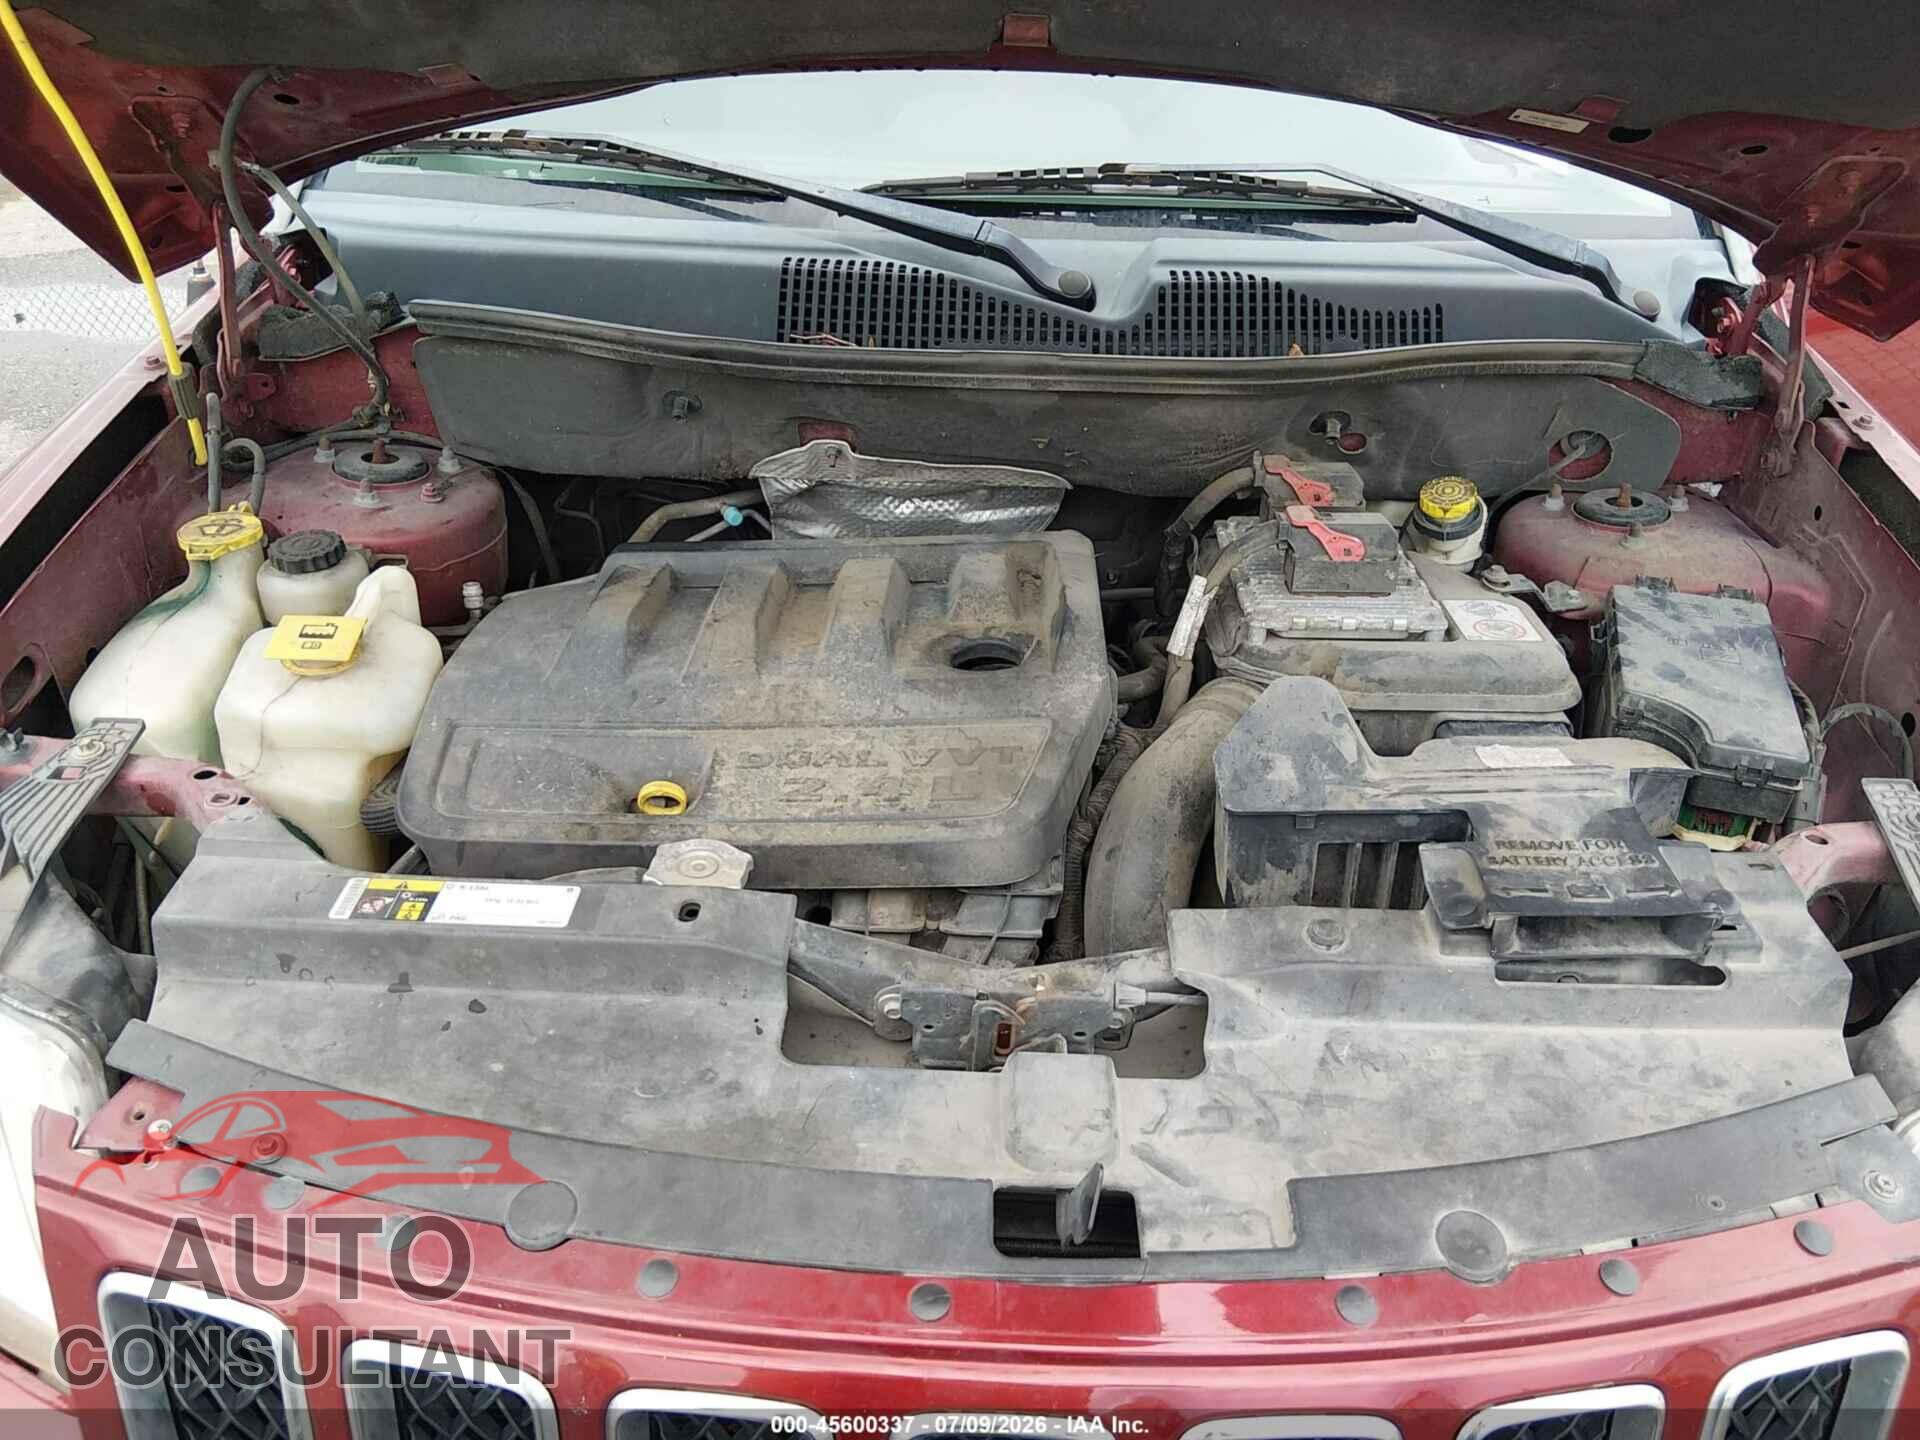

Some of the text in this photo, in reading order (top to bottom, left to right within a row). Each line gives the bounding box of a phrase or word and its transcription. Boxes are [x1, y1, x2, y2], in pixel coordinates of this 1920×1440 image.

[1493, 838, 1628, 852] REMOVE FOR
[1487, 854, 1569, 868] BATTERY
